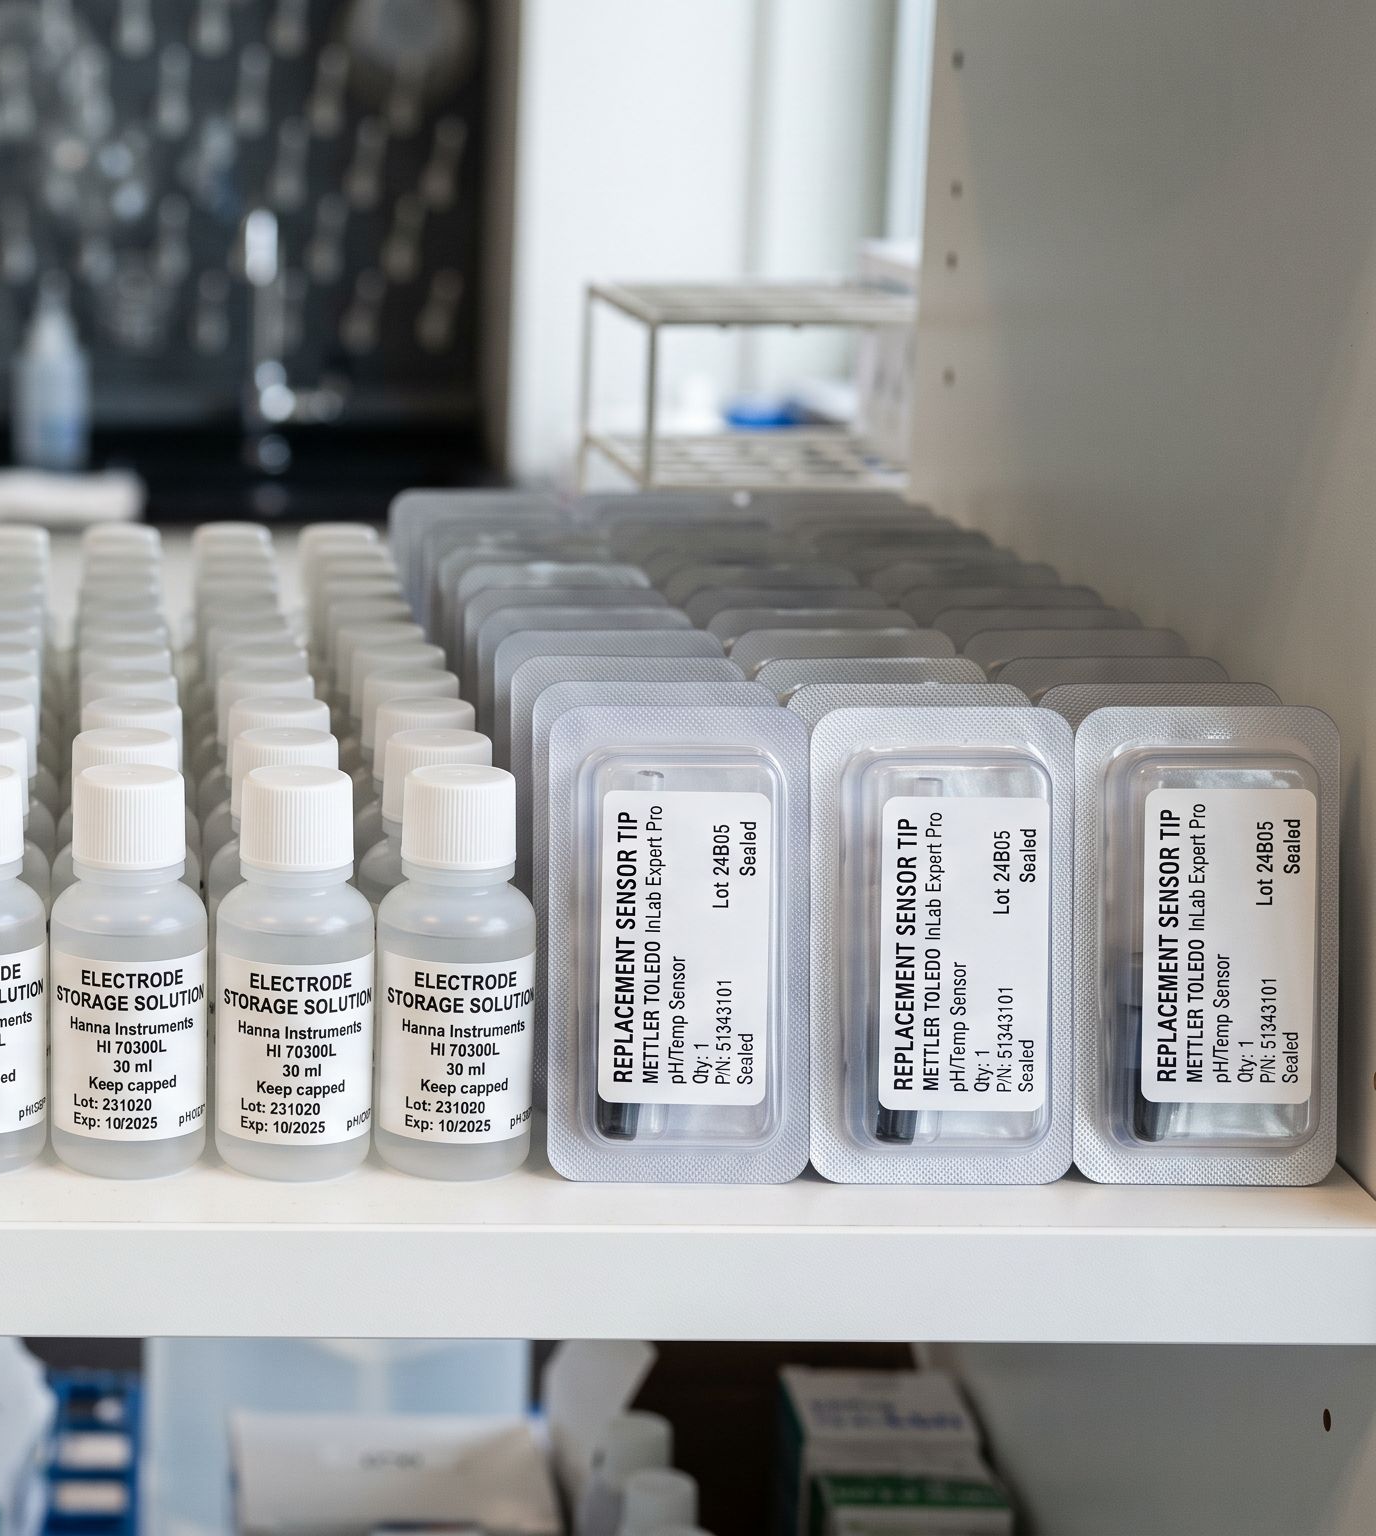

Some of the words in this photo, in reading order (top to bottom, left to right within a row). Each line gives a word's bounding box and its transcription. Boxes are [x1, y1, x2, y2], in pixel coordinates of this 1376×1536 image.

[618, 812, 637, 842] TIP
[646, 806, 662, 830] Pro
[926, 813, 942, 837] Pro
[1160, 810, 1180, 840] TIP
[1189, 804, 1205, 828] Pro
[739, 822, 756, 876] Sealed
[898, 819, 917, 849] TIP
[1257, 822, 1273, 872] 24B05
[1283, 820, 1300, 874] Sealed
[646, 837, 666, 885] Expert
[713, 825, 729, 875] 24B05
[993, 831, 1010, 881] 24B05
[1019, 829, 1036, 882] Sealed
[1189, 835, 1209, 883] Expert
[925, 844, 945, 891] Expert
[616, 850, 637, 929] SENSOR
[713, 882, 728, 908] Lot
[896, 857, 916, 935] SENSOR
[993, 889, 1009, 914] Lot
[1159, 848, 1179, 928] SENSOR
[1256, 879, 1273, 905] Lot
[645, 892, 661, 932] InLab
[925, 899, 941, 939] InLab
[1189, 890, 1205, 930] InLab
[82, 969, 183, 988] ELECTRODE
[250, 973, 351, 992] ELECTRODE
[415, 971, 516, 990] ELECTRODE
[644, 942, 660, 1004] TOLEDO
[669, 956, 685, 1009] Sensor
[925, 949, 940, 1011] TOLEDO
[1188, 940, 1204, 1002] TOLEDO
[1213, 954, 1229, 1008] Sensor
[57, 985, 128, 1011] STORAGE
[224, 988, 298, 1014] STORAGE
[304, 987, 371, 1014] SOLUTION
[388, 987, 464, 1013] STORAGE
[950, 962, 966, 1015] Sensor
[614, 937, 635, 1082] REPLACEMENT
[716, 981, 732, 1051] 51343101
[894, 943, 915, 1090] REPLACEMENT
[997, 988, 1013, 1058] 51343101
[1157, 935, 1178, 1081] REPLACEMENT
[1261, 980, 1276, 1048] 51343101
[71, 1016, 110, 1034] Hanna
[116, 1017, 193, 1035] Instruments
[239, 1020, 279, 1038] Hanna
[285, 1021, 361, 1039] Instruments
[403, 1018, 444, 1037] Hanna
[451, 1020, 525, 1038] Instruments
[97, 1040, 110, 1053] HI
[116, 1040, 166, 1054] 70300L
[267, 1044, 280, 1057] HI
[286, 1044, 336, 1058] 70300L
[431, 1042, 445, 1056] HI
[450, 1043, 499, 1057] 70300L
[643, 1011, 659, 1083] METTLER
[668, 1016, 688, 1083] pH/Temp
[737, 1034, 753, 1084] Sealed
[923, 1018, 939, 1090] METTLER
[950, 1022, 969, 1091] pH/Temp
[1187, 1009, 1203, 1082] METTLER
[1213, 1015, 1233, 1082] pH/Temp
[1282, 1033, 1298, 1083] Sealed
[114, 1060, 130, 1073] 30
[136, 1059, 151, 1072] ml
[283, 1065, 299, 1077] 30
[305, 1064, 321, 1077] ml
[447, 1063, 463, 1075] 30
[469, 1063, 485, 1075] ml
[693, 1057, 712, 1083] Qty:
[715, 1057, 730, 1084] P/N:
[974, 1064, 993, 1092] Qty:
[997, 1063, 1011, 1092] P/N:
[1018, 1040, 1033, 1092] Sealed
[1237, 1055, 1257, 1082] Qty:
[1260, 1055, 1275, 1082] P/N:
[90, 1076, 123, 1094] Keep
[128, 1075, 176, 1094] capped
[257, 1081, 292, 1098] Keep
[297, 1080, 344, 1098] capped
[421, 1079, 456, 1096] Keep
[461, 1078, 508, 1096] capped
[103, 1098, 151, 1111] 231020
[271, 1102, 320, 1115] 231020
[436, 1101, 485, 1114] 231020
[273, 1121, 325, 1134] 10/2025
[439, 1120, 490, 1132] 10/2025
